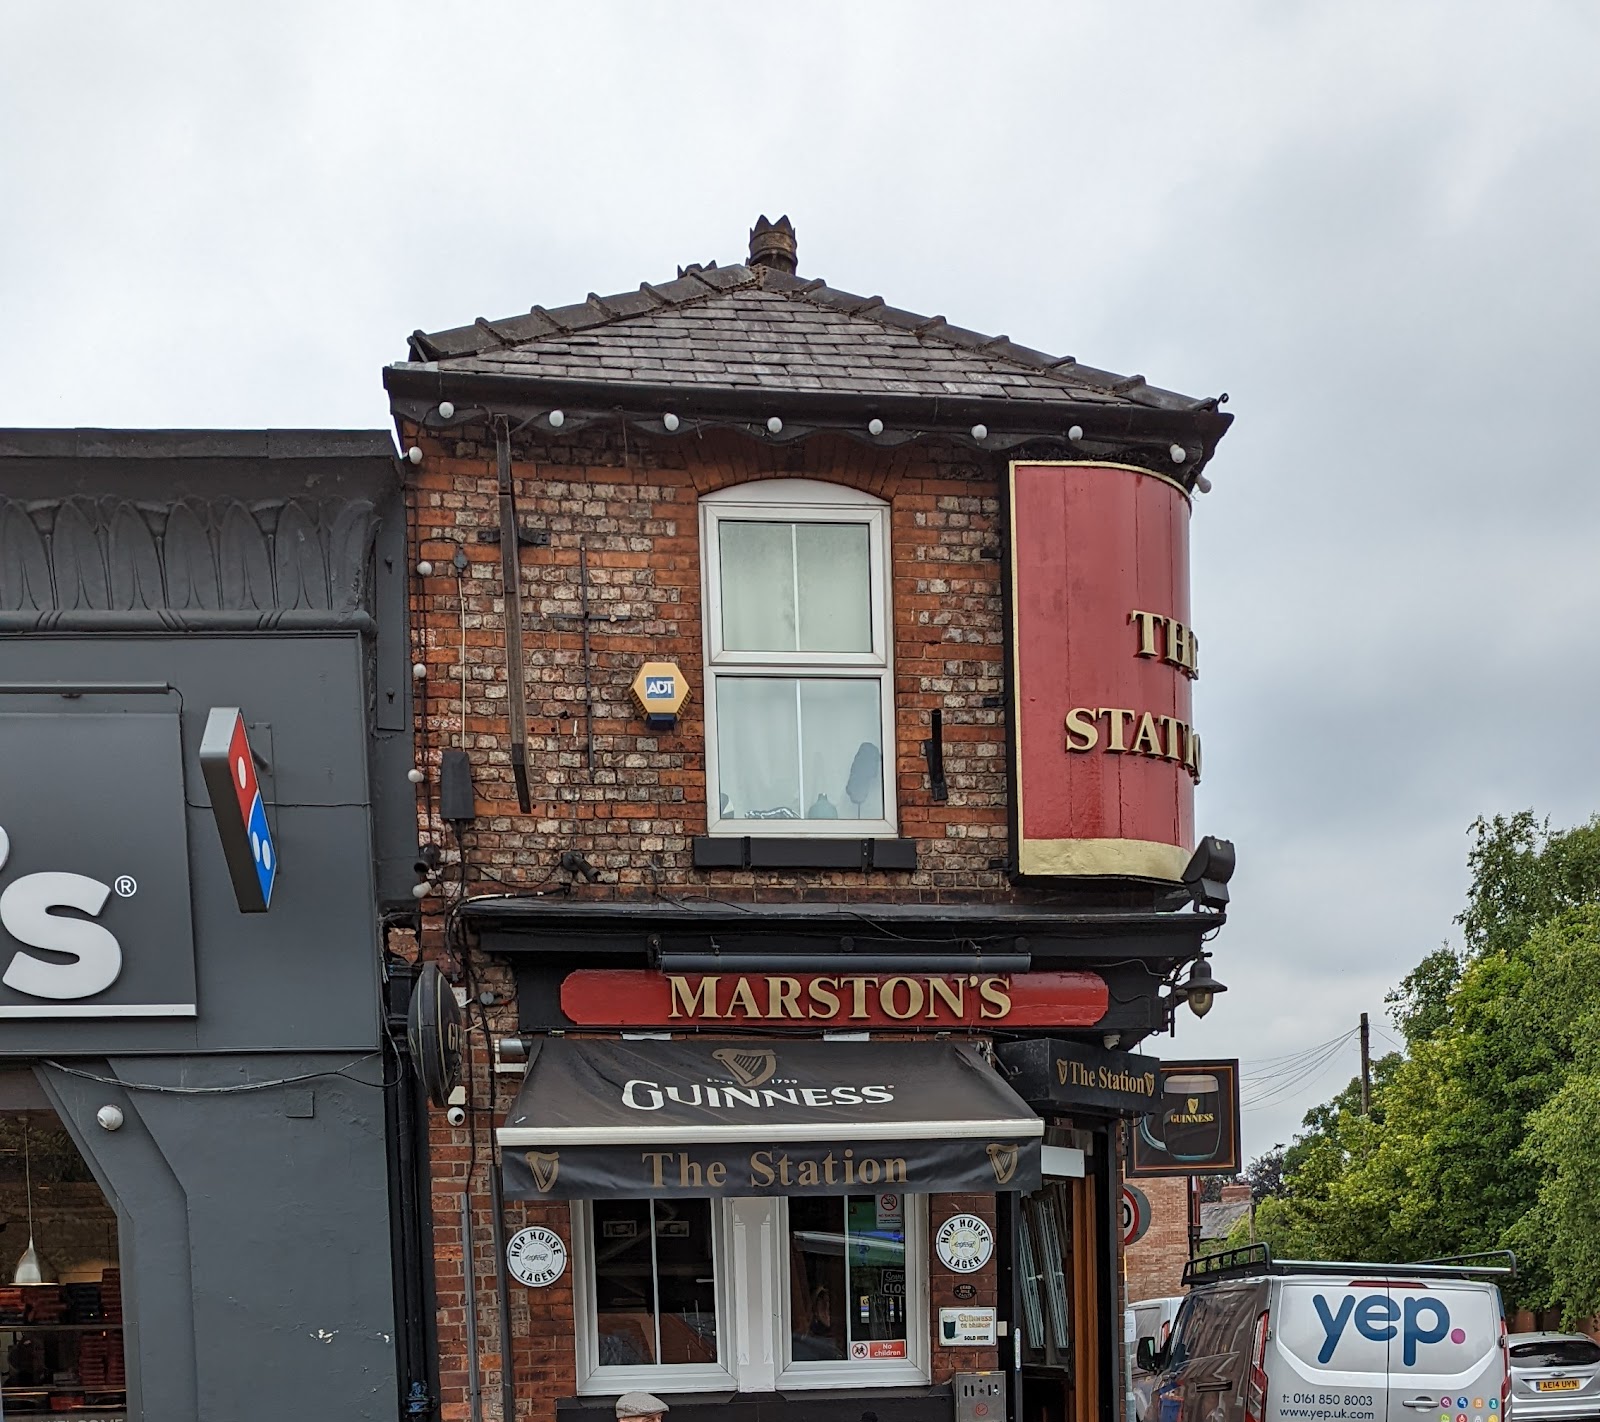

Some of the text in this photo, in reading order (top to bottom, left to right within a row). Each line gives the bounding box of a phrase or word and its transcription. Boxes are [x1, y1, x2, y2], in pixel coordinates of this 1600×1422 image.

[647, 681, 675, 694] ADT
[667, 976, 1013, 1019] MARSTON'S
[1068, 1061, 1145, 1094] The Station
[621, 1079, 894, 1111] GUINNESS
[1170, 1113, 1214, 1123] GUINNESS
[641, 1149, 909, 1188] The Station
[940, 1219, 989, 1244] HOP HOUSE
[511, 1231, 562, 1257] HOP HOUSE
[948, 1256, 981, 1269] LAGER
[520, 1269, 555, 1282] LAGER
[1542, 1381, 1560, 1389] AE14
[1282, 1393, 1373, 1406] t: 0161 850 8003
[1280, 1408, 1375, 1421] www.yep.uk.com
